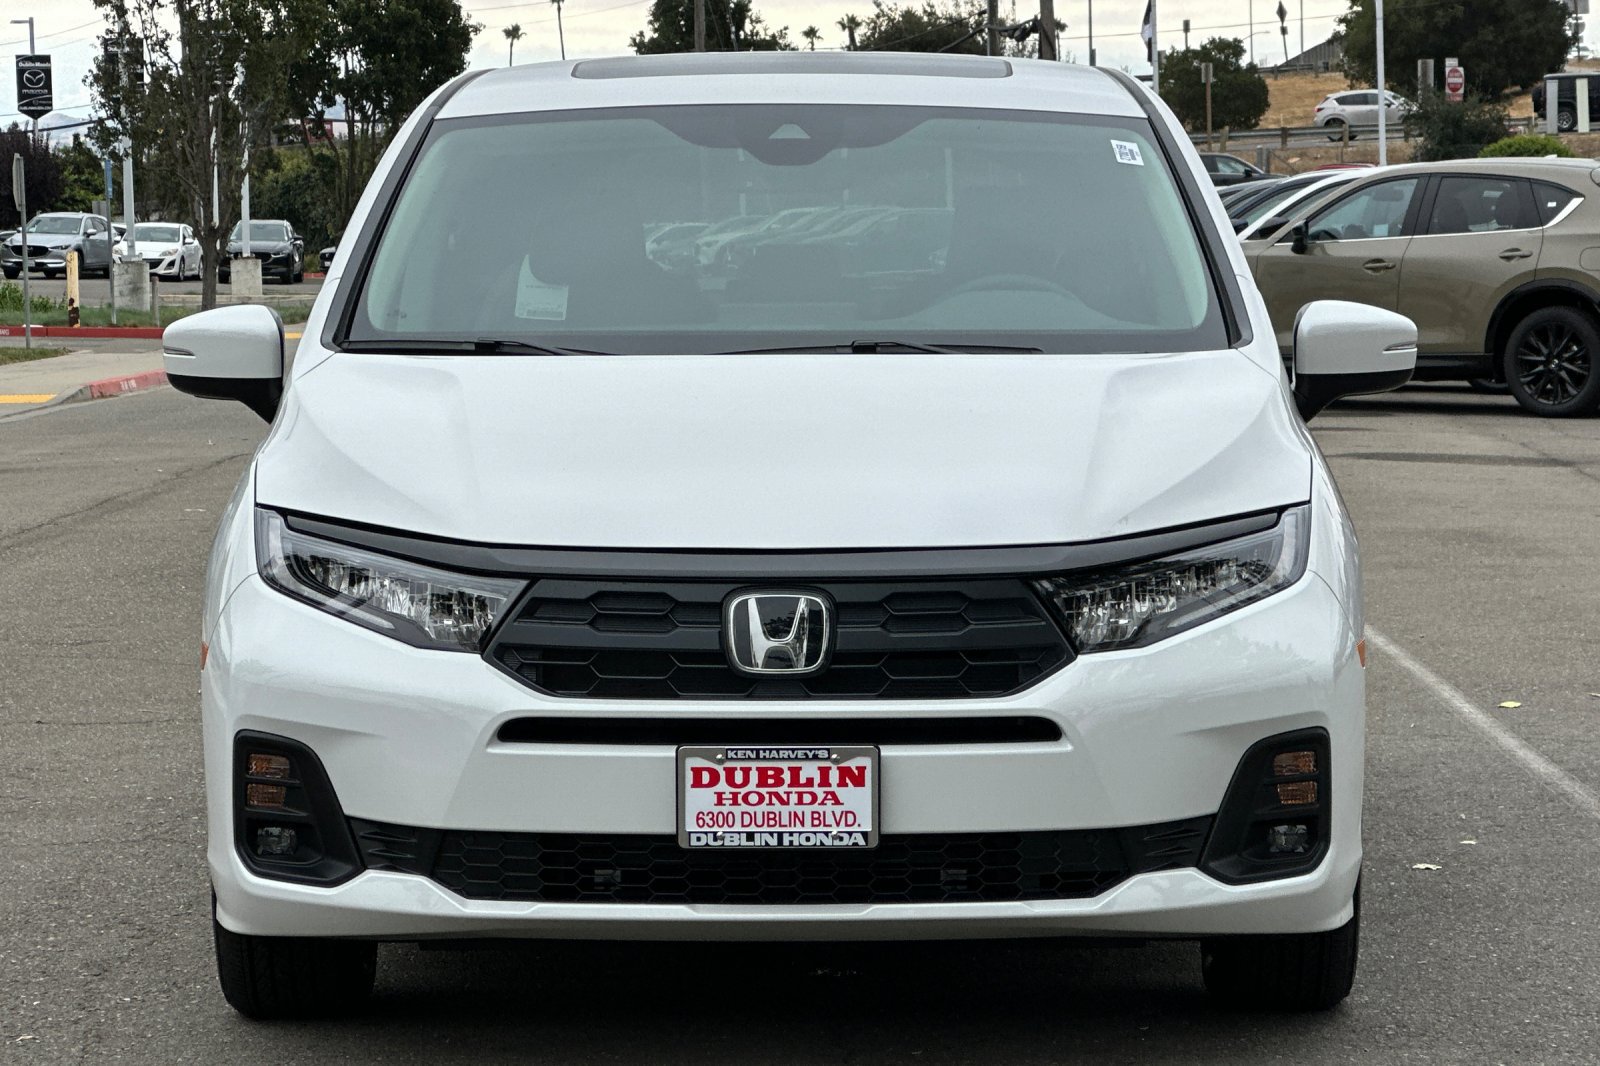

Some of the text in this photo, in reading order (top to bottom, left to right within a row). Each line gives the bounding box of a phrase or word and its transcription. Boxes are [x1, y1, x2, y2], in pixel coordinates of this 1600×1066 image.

[727, 749, 829, 759] KEN HARVEY'S
[690, 766, 867, 788] DUBLIN
[714, 791, 844, 806] HONDA
[695, 811, 861, 828] 6300 DUBLIN BLVD.
[690, 832, 866, 846] DUBLIN HONDA
